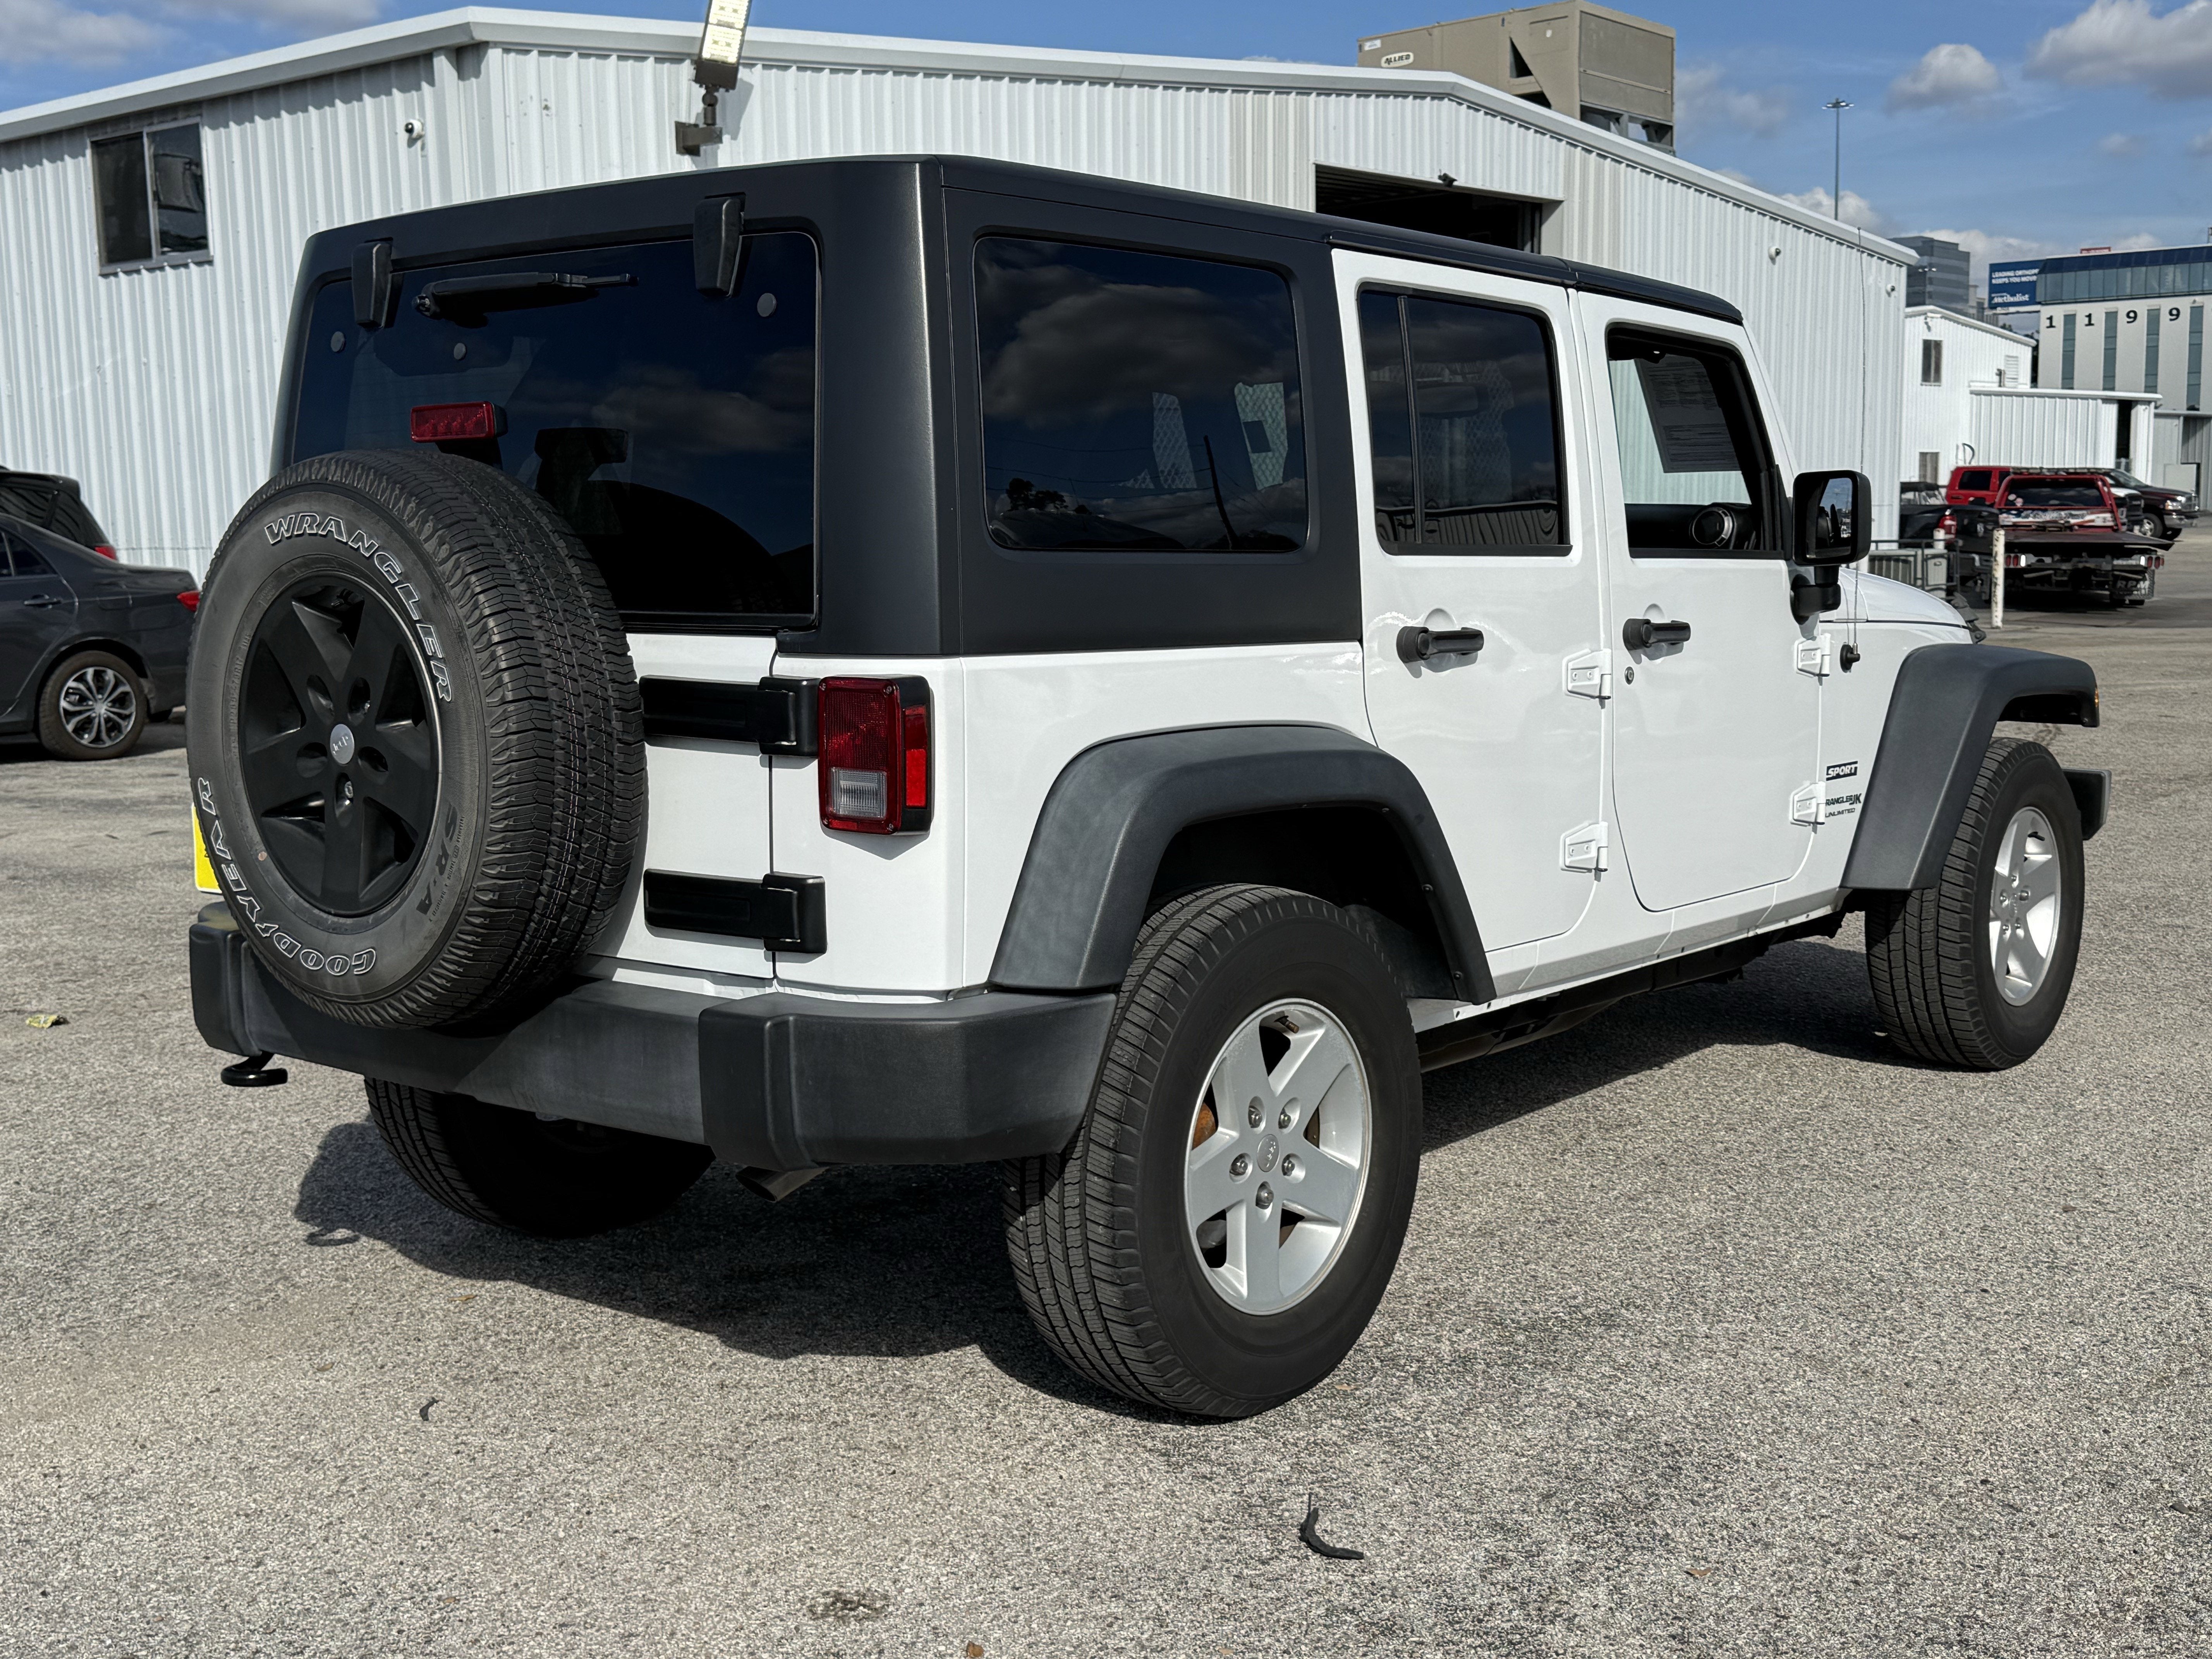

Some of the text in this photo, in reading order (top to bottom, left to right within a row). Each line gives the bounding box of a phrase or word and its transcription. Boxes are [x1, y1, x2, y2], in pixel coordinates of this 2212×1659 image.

[1384, 54, 1410, 65] ALLIED
[264, 513, 452, 702] WRANGLER
[1826, 763, 1858, 779] SPORT
[1826, 793, 1862, 807] RANGLER JK
[1825, 808, 1856, 818] UNLIMITED
[198, 777, 376, 976] GOODYEAR
